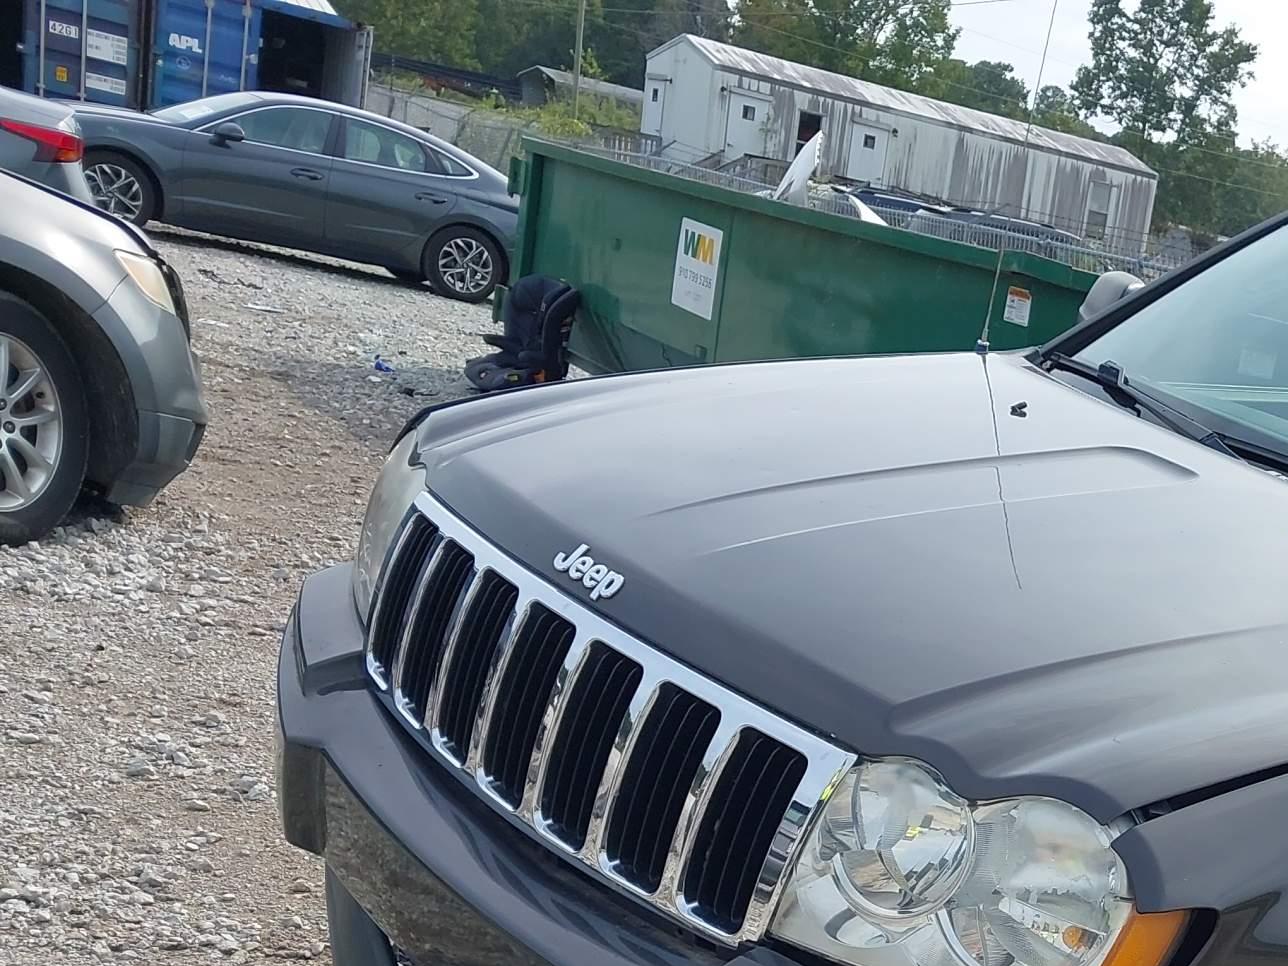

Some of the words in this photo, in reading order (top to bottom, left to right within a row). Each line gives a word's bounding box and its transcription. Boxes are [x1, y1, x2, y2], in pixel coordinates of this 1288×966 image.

[50, 22, 78, 38] 42G1
[168, 33, 203, 54] APL
[683, 228, 715, 266] WM
[553, 543, 625, 601] Jeep
